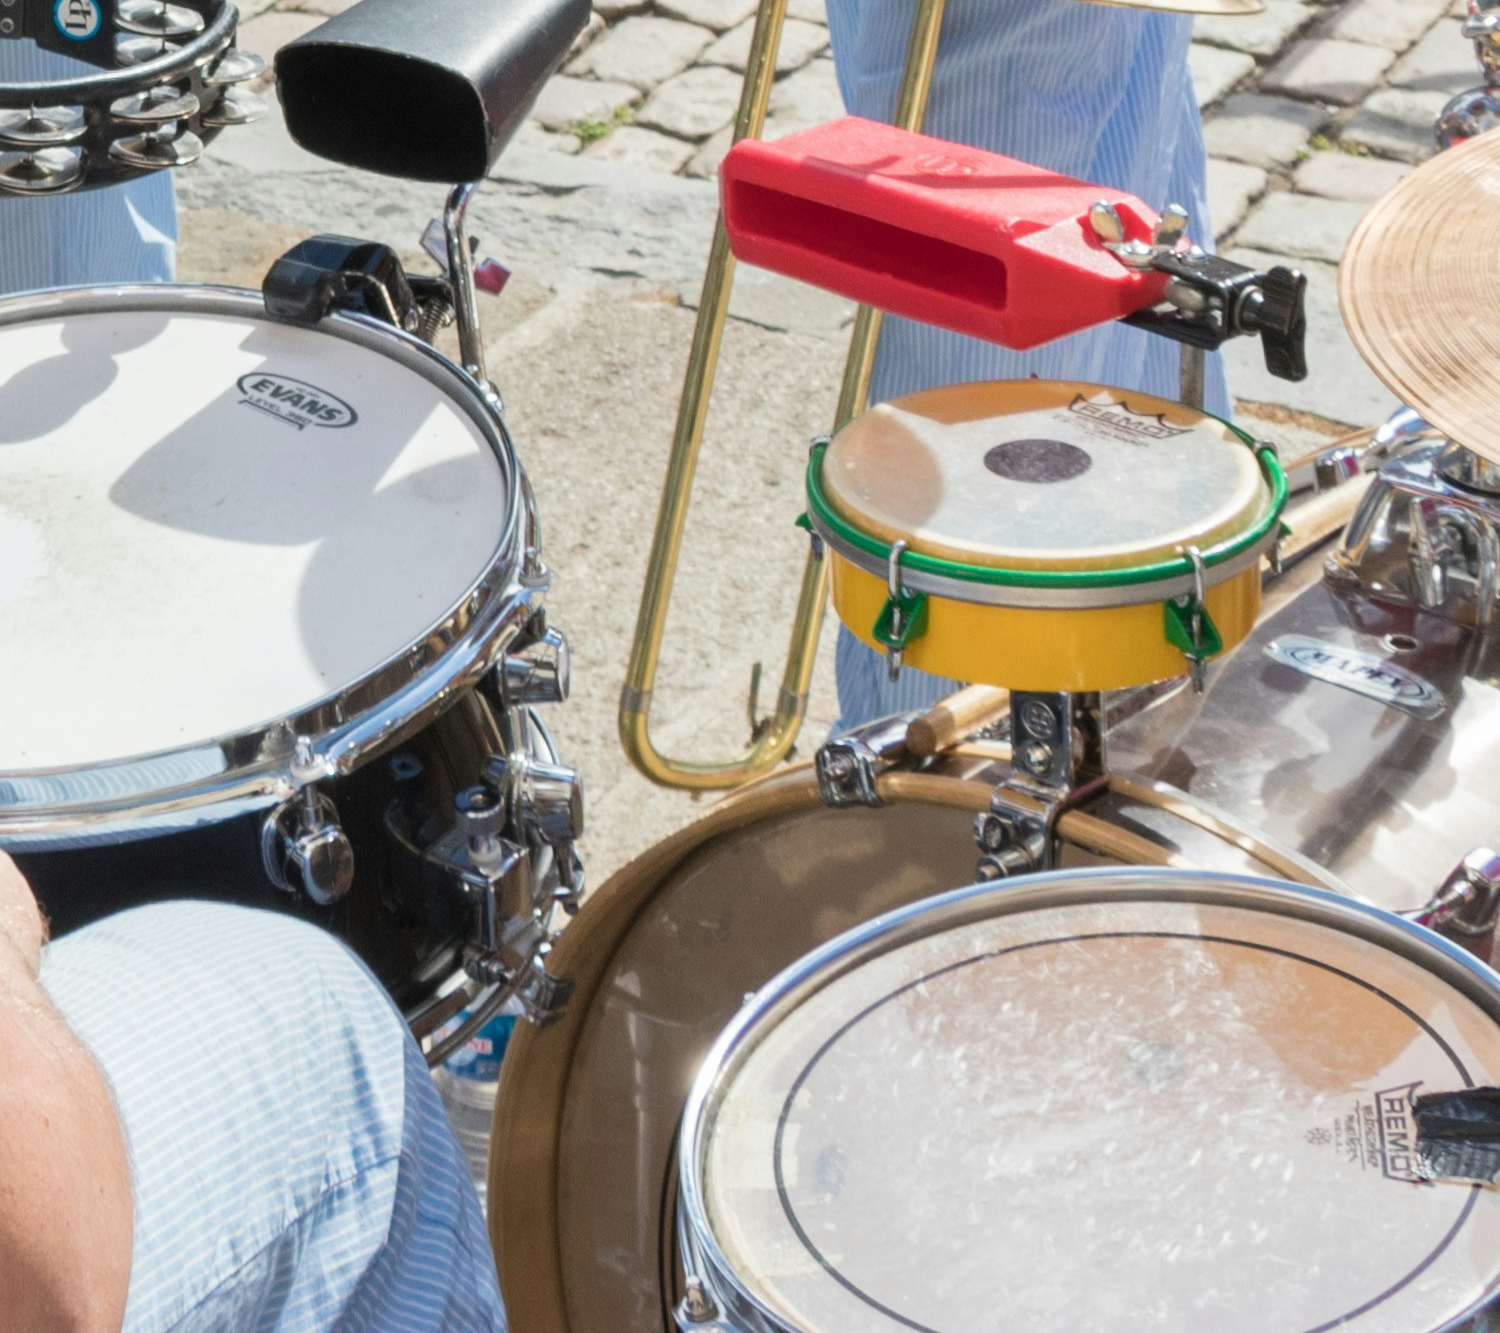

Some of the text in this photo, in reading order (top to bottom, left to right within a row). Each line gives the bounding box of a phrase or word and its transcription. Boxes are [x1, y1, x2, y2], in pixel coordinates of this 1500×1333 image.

[249, 377, 344, 422] EVANS
[1075, 403, 1167, 436] REMO
[1383, 1097, 1412, 1173] REMO
